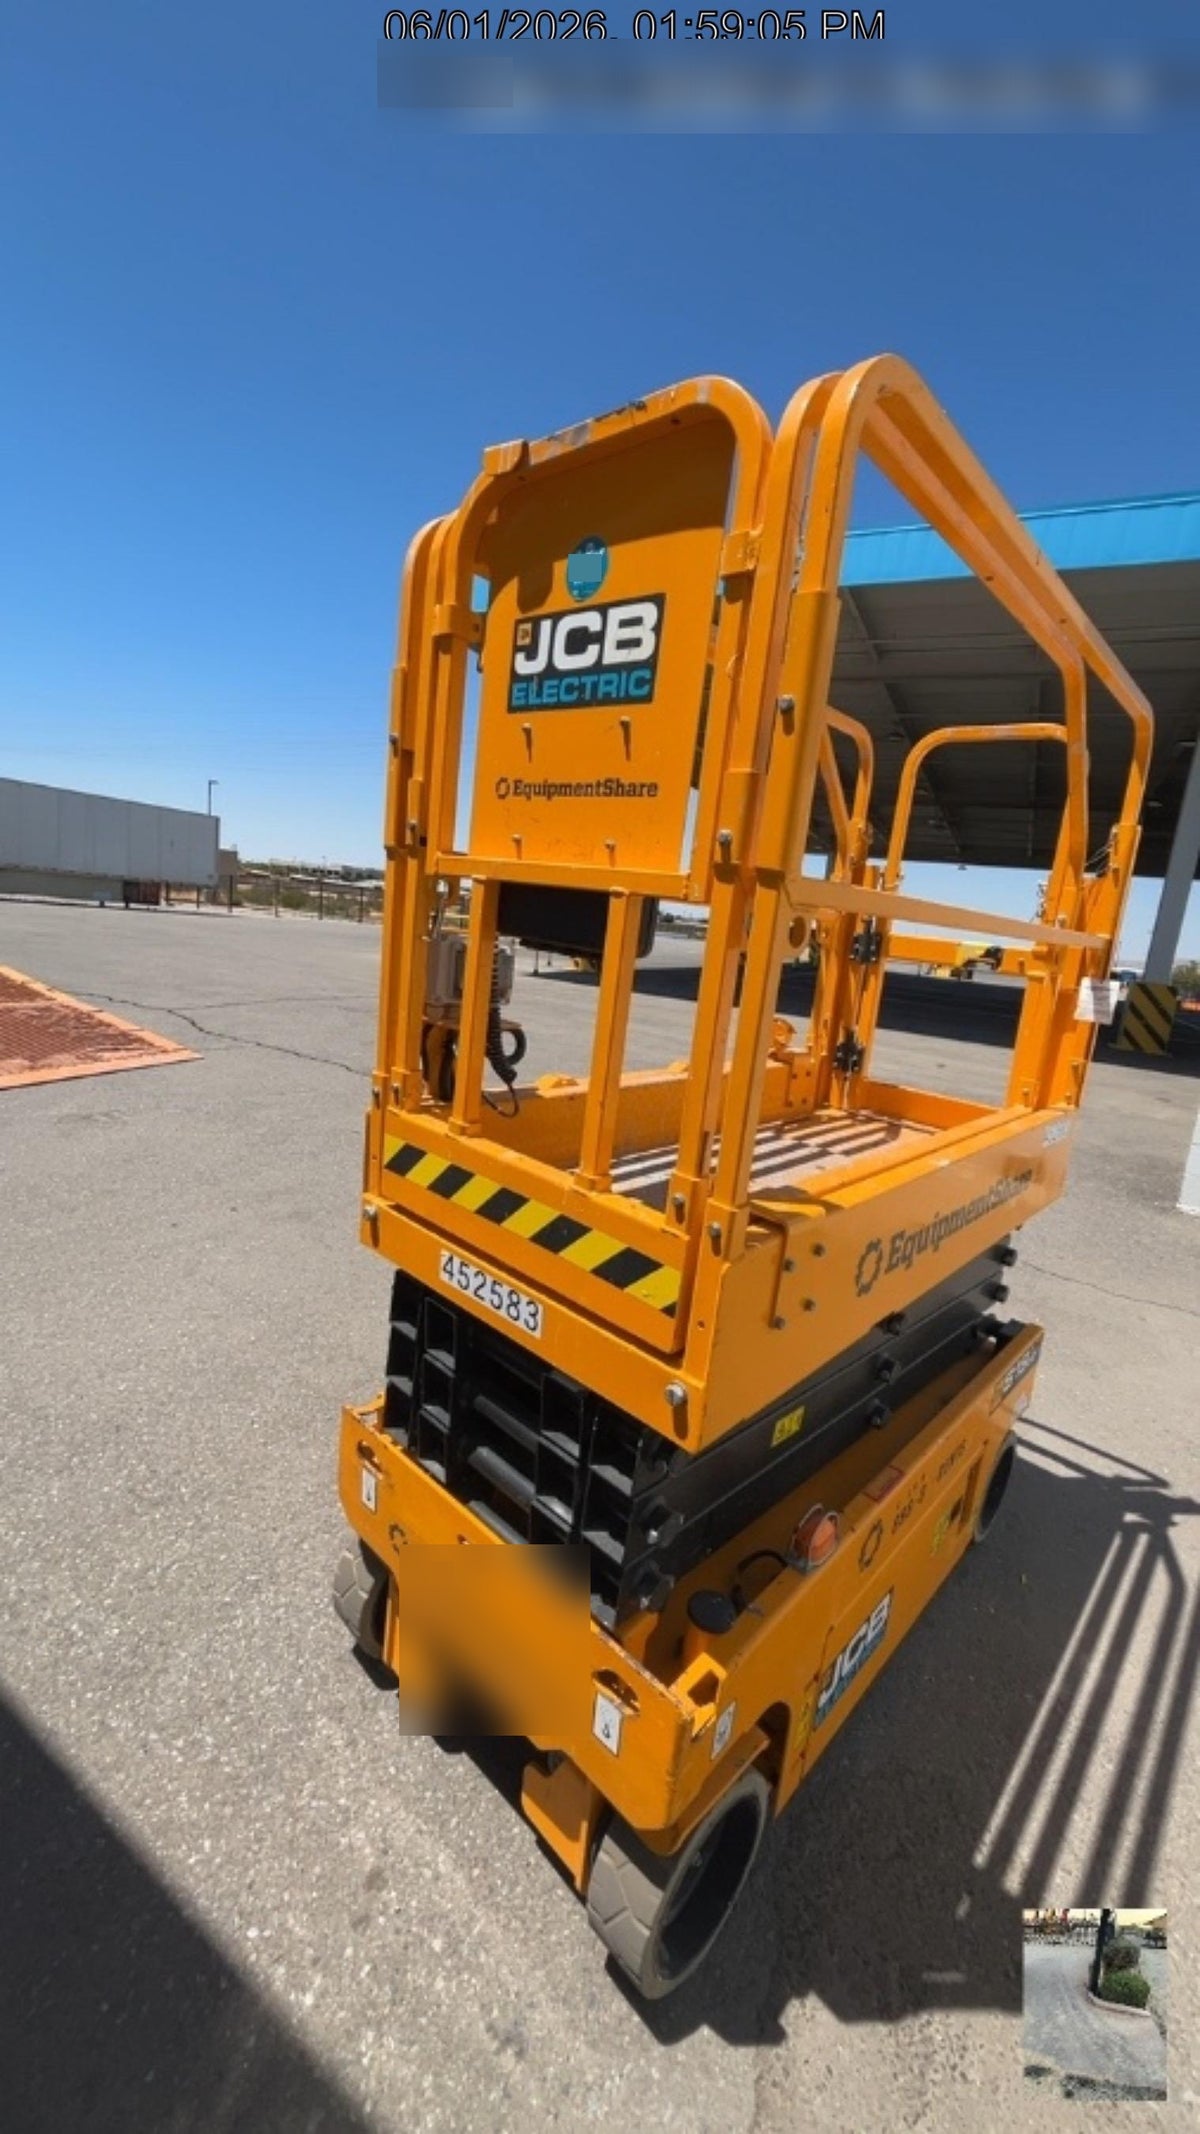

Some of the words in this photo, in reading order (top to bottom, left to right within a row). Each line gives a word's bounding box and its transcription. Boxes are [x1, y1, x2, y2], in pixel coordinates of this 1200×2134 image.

[515, 601, 659, 675] JCB
[511, 668, 652, 706] ELECTRIC
[513, 778, 658, 801] EquipmentShare
[442, 1254, 540, 1332] 452583
[818, 1594, 890, 1708] JCB
